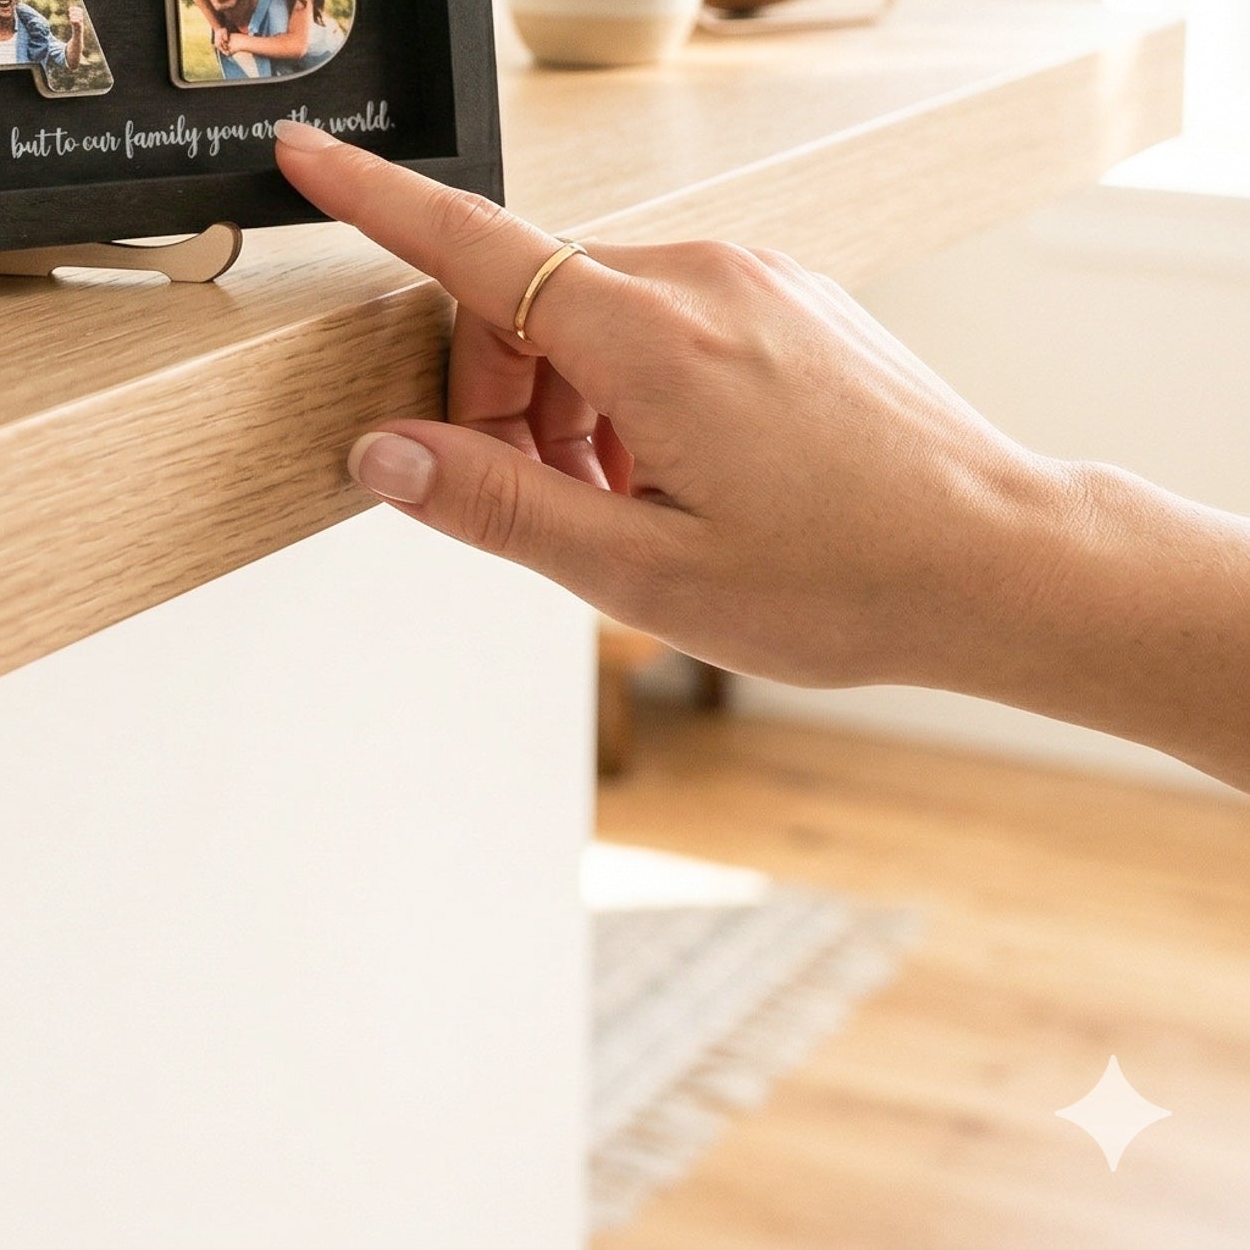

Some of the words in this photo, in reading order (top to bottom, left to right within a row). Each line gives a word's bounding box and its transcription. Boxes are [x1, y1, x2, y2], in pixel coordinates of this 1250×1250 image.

[11, 127, 51, 158] but
[54, 127, 80, 155] to
[82, 132, 121, 152] our
[125, 115, 201, 159] family
[206, 124, 249, 156] you
[251, 119, 276, 140] ar
[329, 100, 396, 134] world.
